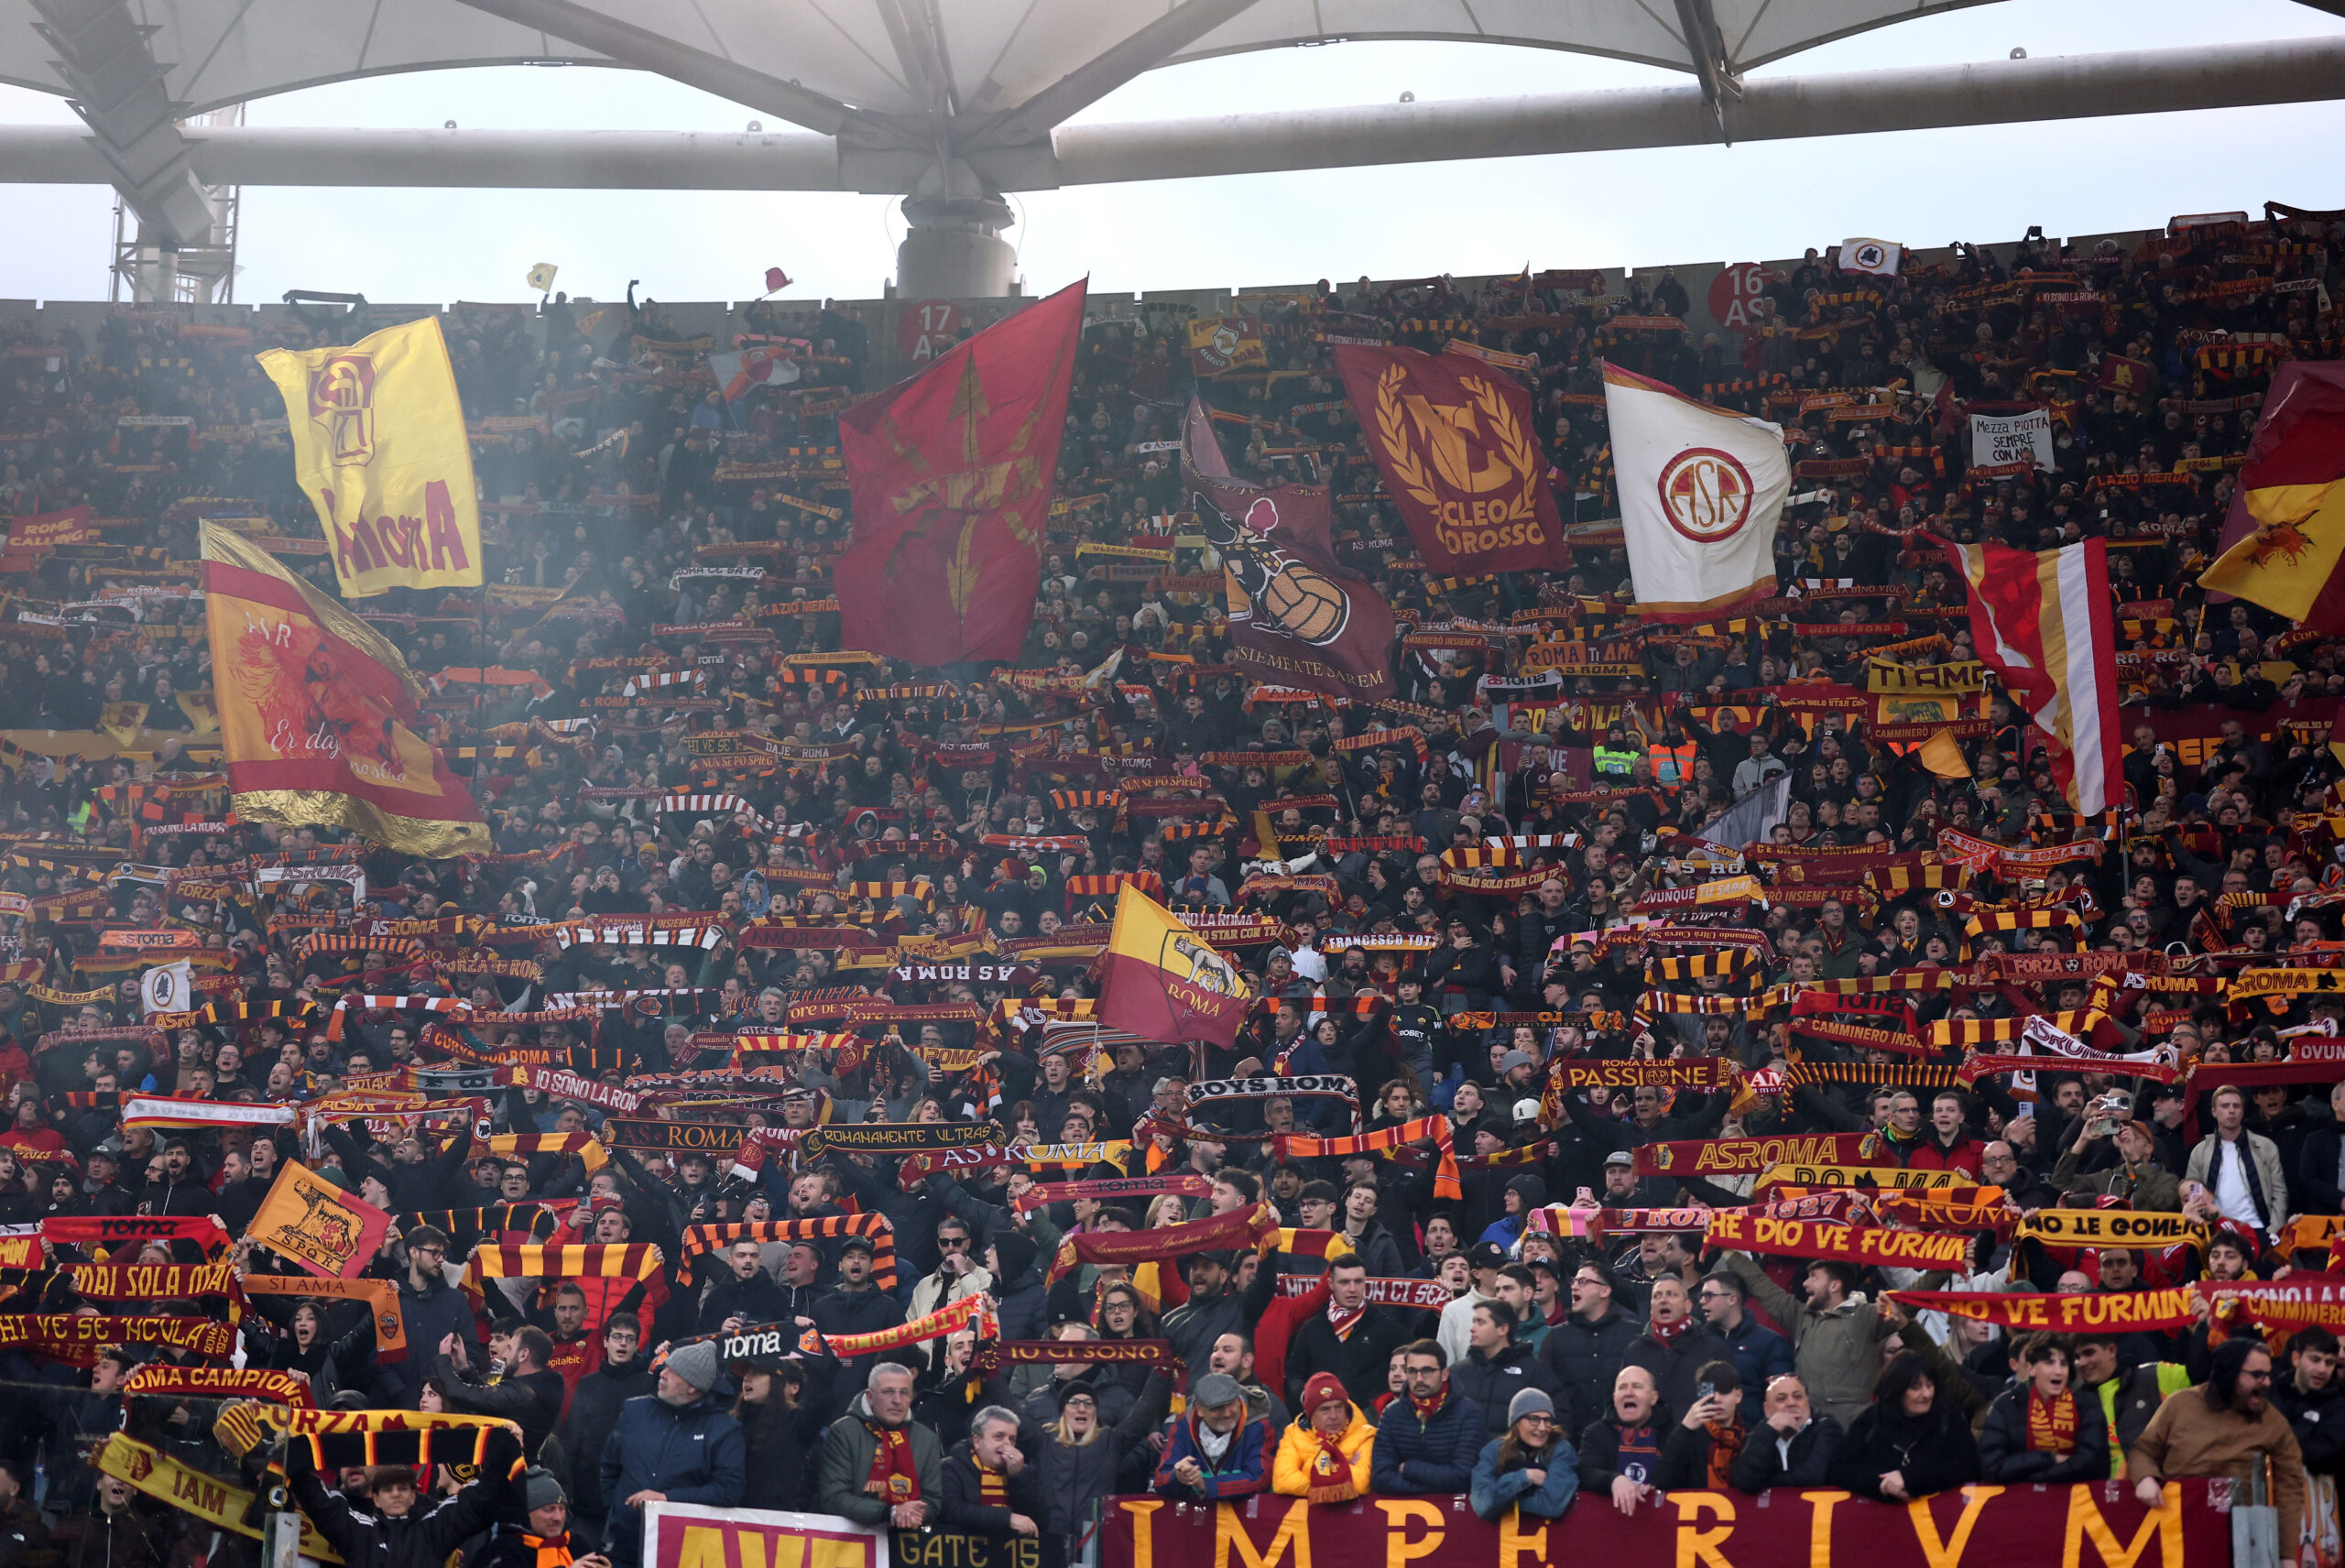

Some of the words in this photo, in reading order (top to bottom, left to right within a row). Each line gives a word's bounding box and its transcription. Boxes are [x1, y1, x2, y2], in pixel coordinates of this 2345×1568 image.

[1730, 269, 1764, 295] 16
[2050, 292, 2067, 301] SONO
[2068, 292, 2078, 301] LA
[2079, 291, 2100, 301] ROMA
[920, 305, 952, 332] 17
[1977, 419, 2010, 434] Mezza
[1993, 431, 2035, 449] SEMPRE
[1992, 446, 2012, 462] CON
[2097, 474, 2140, 487] LAZIO
[2143, 473, 2191, 485] MERDA
[1670, 461, 1740, 529] ASR
[24, 517, 75, 535] ROME
[2140, 523, 2187, 535] ROMA
[9, 530, 84, 548] CALLING
[710, 621, 744, 630] ROMA
[1445, 636, 1475, 646] INSIEME
[697, 655, 725, 665] roma
[1528, 646, 1580, 667] ROMA
[1587, 647, 1600, 662] TI
[1303, 661, 1323, 678] TE
[1579, 664, 1630, 675] ROMA
[1871, 663, 1903, 687] TI
[1505, 671, 1547, 686] roma
[1875, 727, 1928, 738] CAMMINERÒ
[1968, 724, 1975, 734] A
[1977, 723, 1989, 733] TE
[1358, 733, 1389, 746] DELLA
[765, 742, 791, 757] DAJE
[802, 746, 830, 758] ROMA
[722, 756, 733, 768] SE
[350, 757, 409, 785] nostro
[1121, 778, 1140, 791] NUN
[1141, 777, 1153, 789] SE
[1169, 776, 1203, 788] SPIEGA
[281, 866, 363, 880] ASROMA
[1481, 877, 1503, 888] SOLO
[1504, 874, 1527, 887] STAR
[1528, 869, 1550, 883] CON
[1699, 885, 1715, 898] TU
[1786, 889, 1833, 903] INSIEME
[1835, 890, 1842, 902] A
[1842, 889, 1854, 902] TE
[369, 919, 439, 936] ASROMA
[657, 918, 689, 930] INSIEME
[691, 918, 698, 928] A
[699, 916, 714, 928] TE
[1217, 913, 1253, 926] ROMA
[137, 931, 175, 945] roma
[1211, 928, 1238, 942] STAR
[1240, 927, 1260, 940] CON
[1261, 925, 1276, 937] TE
[1329, 934, 1404, 950] FRANCESCO
[1008, 938, 1054, 951] Commando
[1081, 936, 1109, 945] Curva
[2013, 956, 2065, 975] FORZA
[2082, 954, 2130, 973] ROMA
[896, 965, 973, 982] ROMA
[978, 965, 1017, 982] AS
[2122, 970, 2198, 993] ASROMA
[1168, 982, 1221, 1018] ROMA
[1838, 993, 1906, 1015] roma
[821, 1003, 838, 1016] DE
[848, 1008, 885, 1024] Core
[888, 1012, 909, 1021] DE
[940, 1007, 977, 1019] CITTÀ
[1499, 1011, 1562, 1025] roma
[1811, 1019, 1891, 1044] CAMMINERO
[509, 1048, 551, 1065] ROMA
[1601, 1059, 1640, 1069] ROMA
[1642, 1058, 1676, 1068] CLUB
[535, 1067, 550, 1088] IO
[551, 1073, 589, 1100] SONO
[590, 1082, 610, 1103] LA
[1570, 1065, 1709, 1088] PASSIONE
[1190, 1077, 1271, 1101] BOYS
[668, 1126, 744, 1148] ROMA
[824, 1127, 927, 1146] ROMANAMENTE
[934, 1126, 991, 1143] ULTRAS
[941, 1147, 983, 1168] AS
[1694, 1136, 1838, 1171] ASROMA
[1096, 1176, 1166, 1193] roma
[1763, 1193, 1842, 1220] 1927
[101, 1218, 179, 1236] roma
[1754, 1217, 1804, 1247] DIO
[1815, 1223, 1851, 1250] VE
[74, 1264, 117, 1297] MAI
[125, 1263, 181, 1298] SOLA
[187, 1262, 231, 1295] MAI
[268, 1275, 291, 1291] SI
[295, 1278, 346, 1294] AMA
[1391, 1279, 1411, 1301] CI
[2002, 1296, 2050, 1324] VE
[36, 1315, 69, 1340] VE
[77, 1316, 111, 1341] SE
[215, 1327, 231, 1355] 1927
[723, 1330, 781, 1359] roma
[65, 1344, 85, 1359] TE
[1010, 1345, 1041, 1361] IO
[1046, 1345, 1078, 1360] CI
[1081, 1345, 1161, 1361] SONO
[190, 1367, 303, 1409] CAMPIONE
[1118, 1480, 2185, 1568] IMPERIVM
[898, 1532, 990, 1568] GATE
[1004, 1533, 1041, 1568] 15
